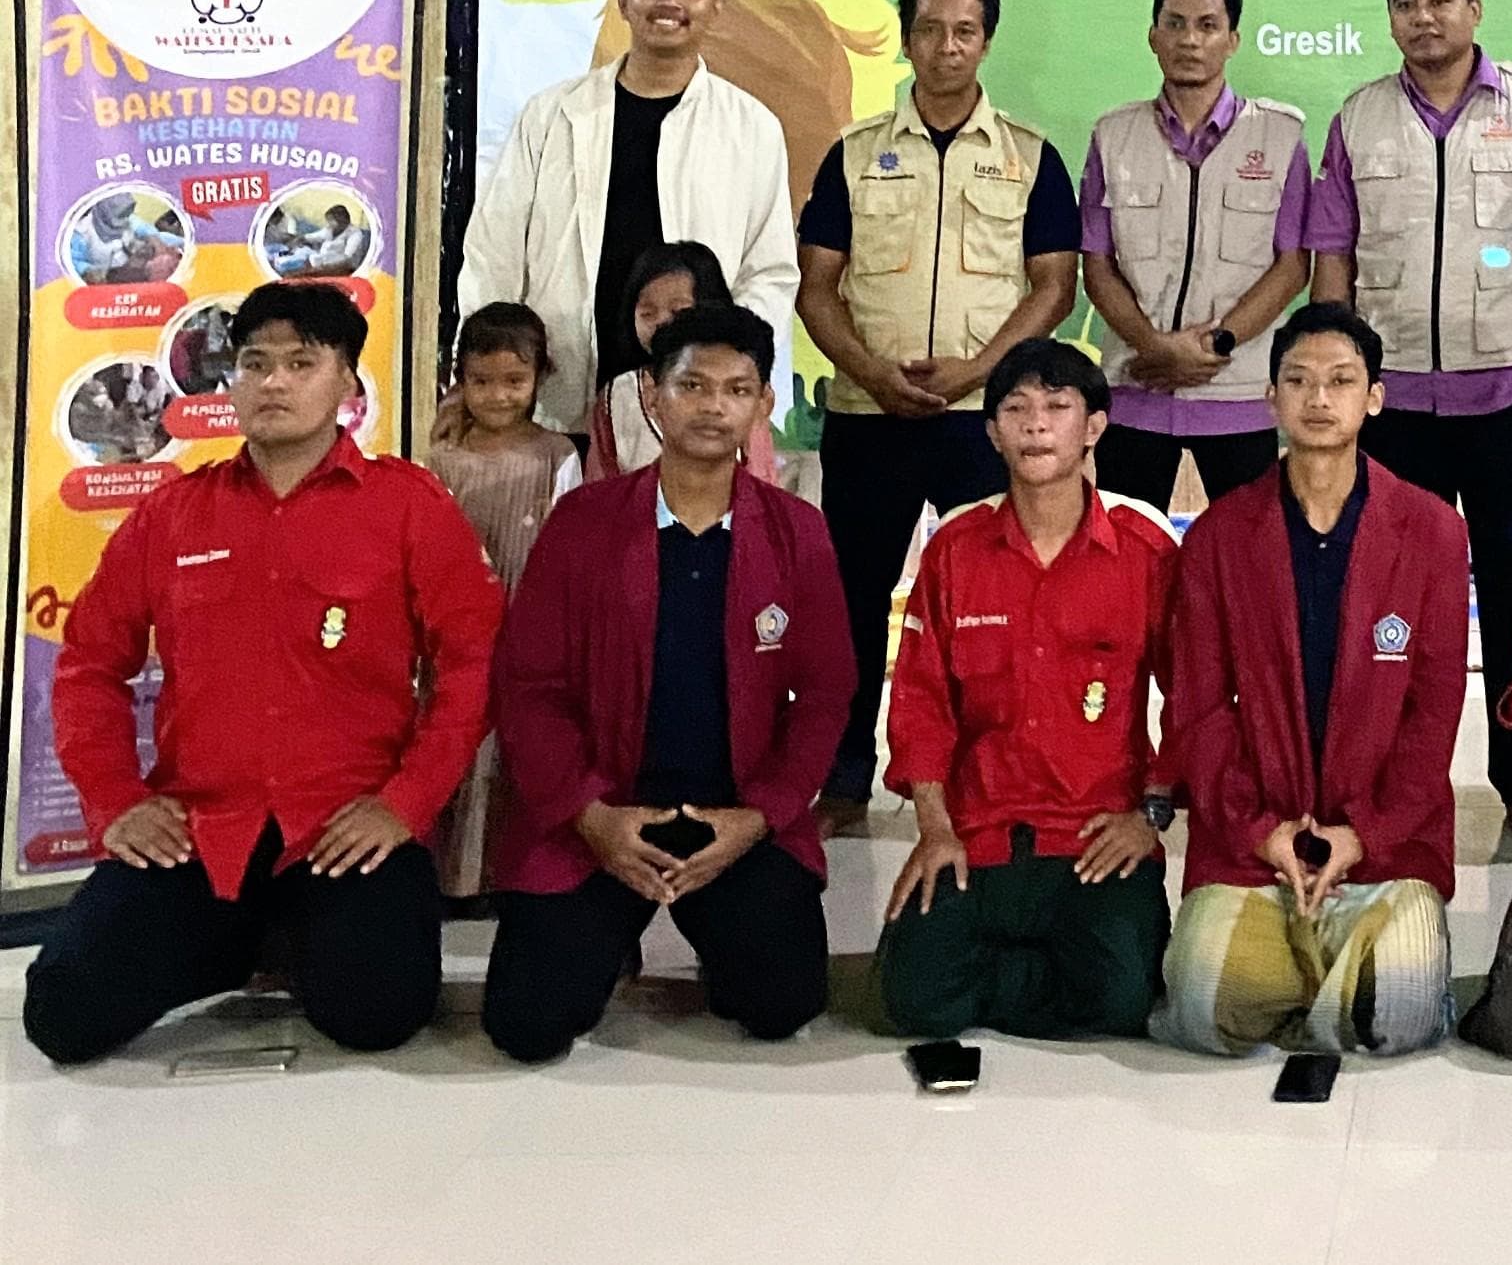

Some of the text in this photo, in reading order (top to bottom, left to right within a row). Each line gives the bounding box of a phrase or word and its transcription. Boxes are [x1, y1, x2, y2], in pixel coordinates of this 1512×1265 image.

[1256, 23, 1364, 56] Gresik
[93, 85, 360, 129] BAKTI SOSIAL
[139, 119, 300, 144] KESEHATAN
[95, 143, 360, 181] RS. WATES HUSADA
[191, 176, 264, 205] GRATIS
[85, 470, 162, 485] KONSULTASI
